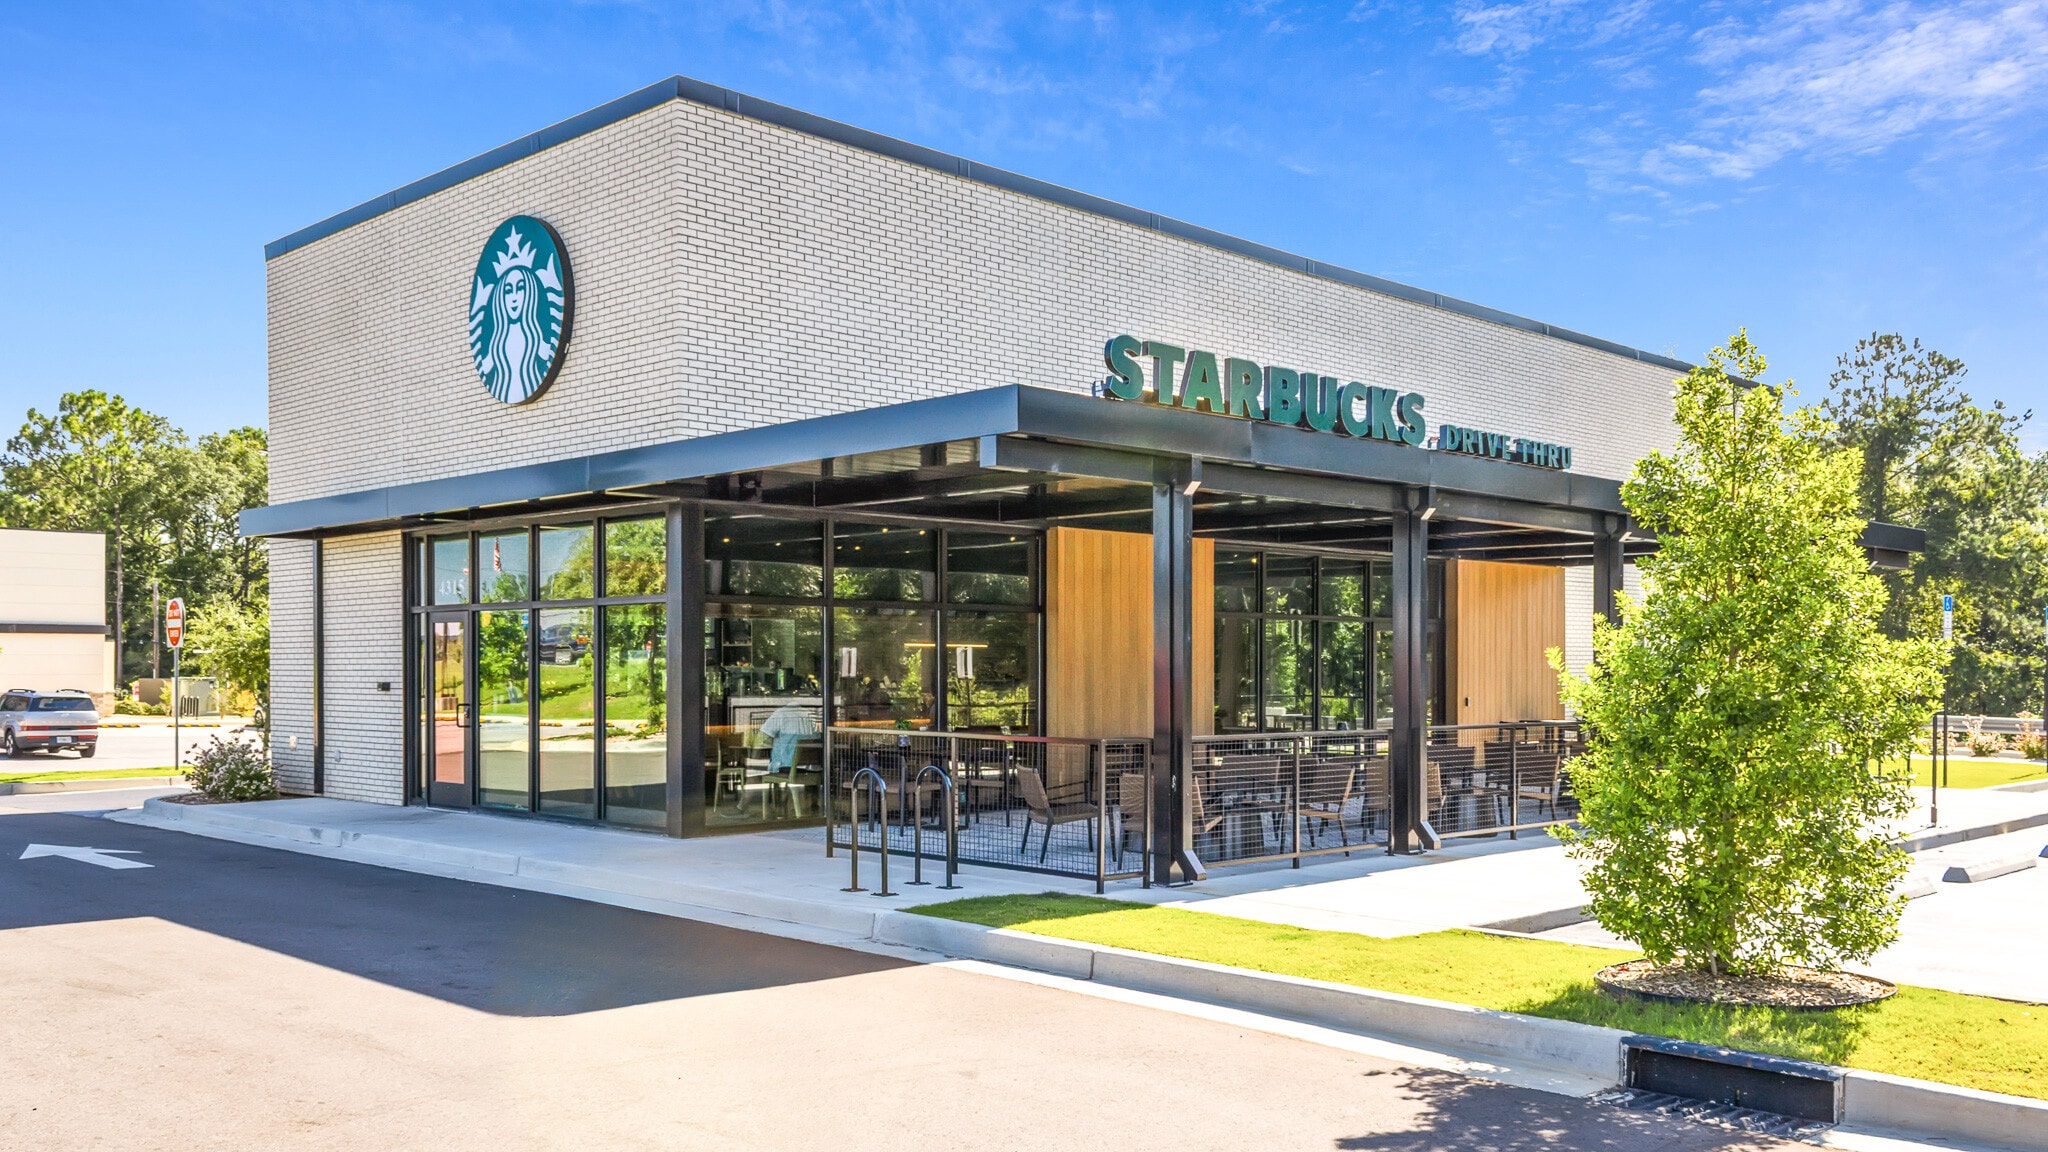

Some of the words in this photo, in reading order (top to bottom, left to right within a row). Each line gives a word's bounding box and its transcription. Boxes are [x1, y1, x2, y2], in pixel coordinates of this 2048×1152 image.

[1104, 334, 1427, 446] STARBUCKS
[1440, 424, 1512, 461] DRIVE
[1515, 438, 1572, 469] THRU
